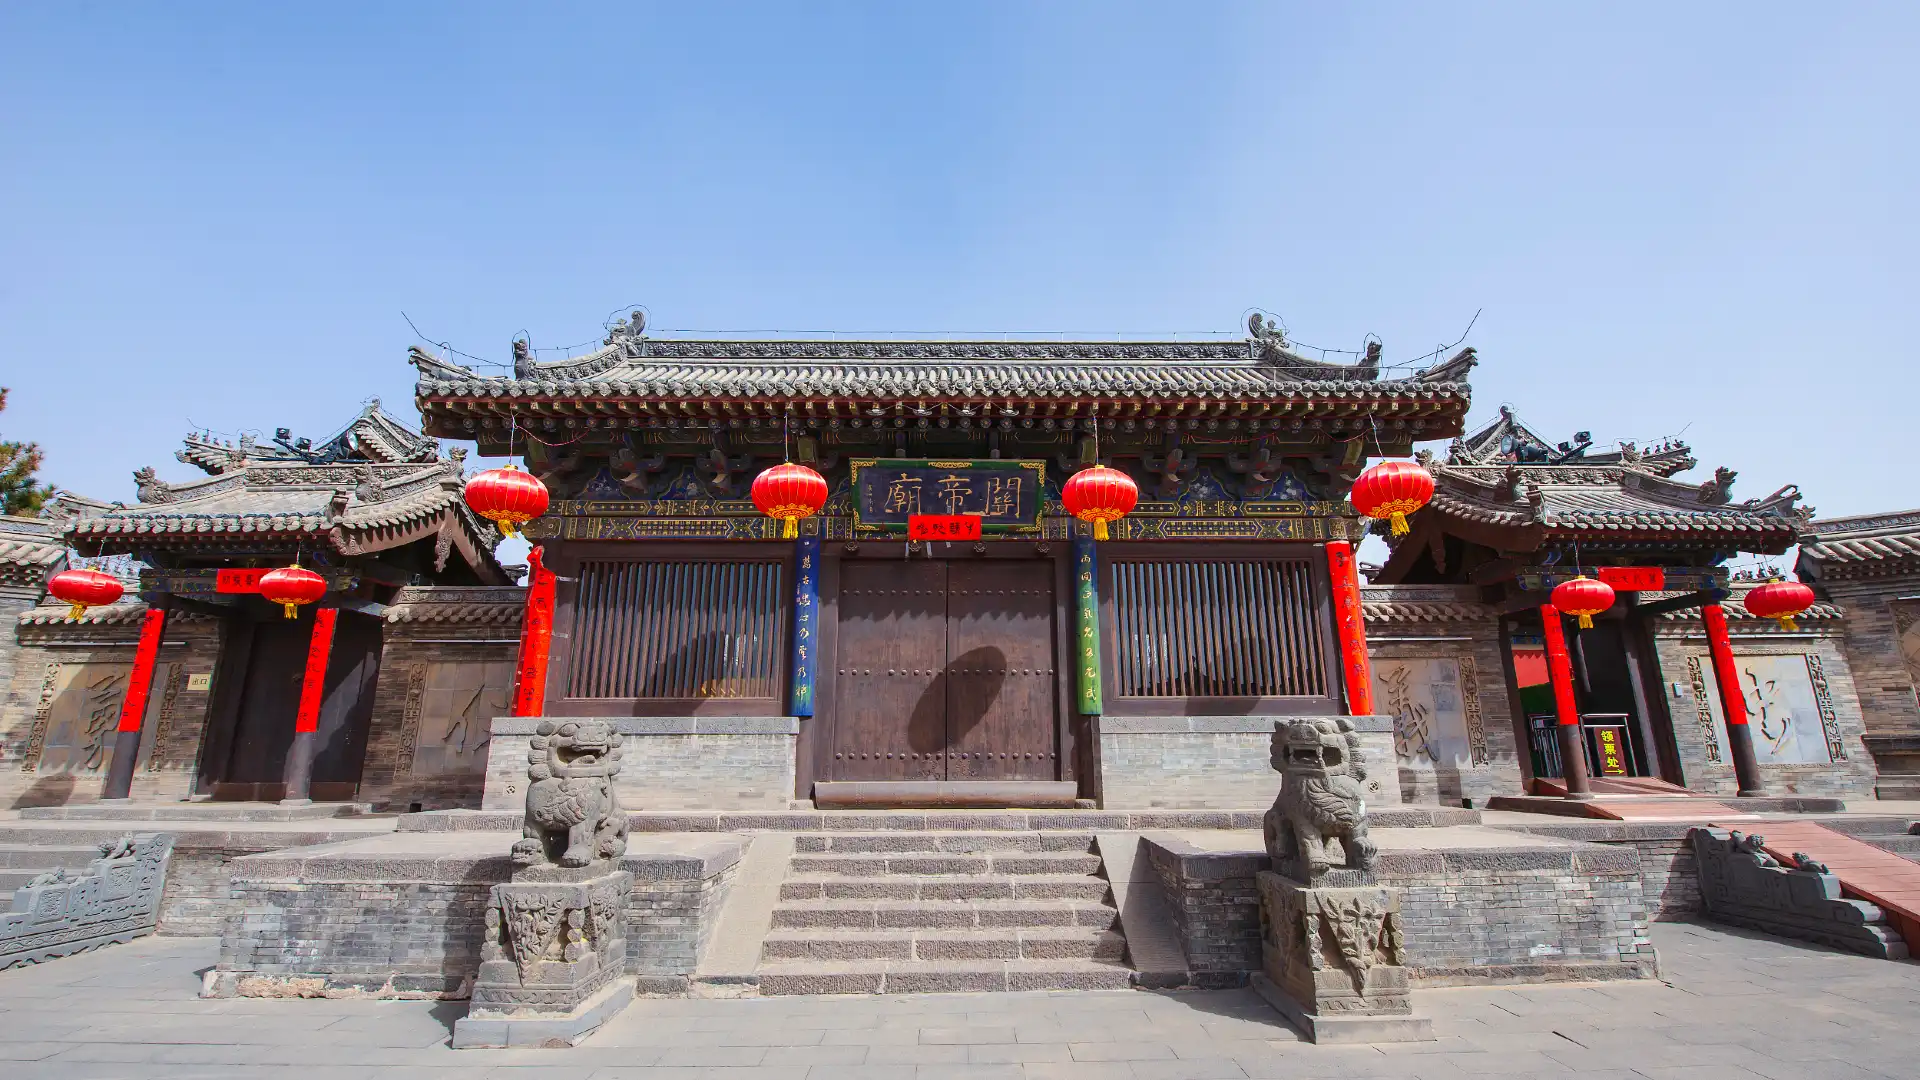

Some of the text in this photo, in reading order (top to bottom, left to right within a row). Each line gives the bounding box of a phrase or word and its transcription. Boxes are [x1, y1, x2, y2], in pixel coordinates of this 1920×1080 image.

[884, 473, 1022, 518] 關帝廟
[1600, 730, 1620, 768] 领票处
